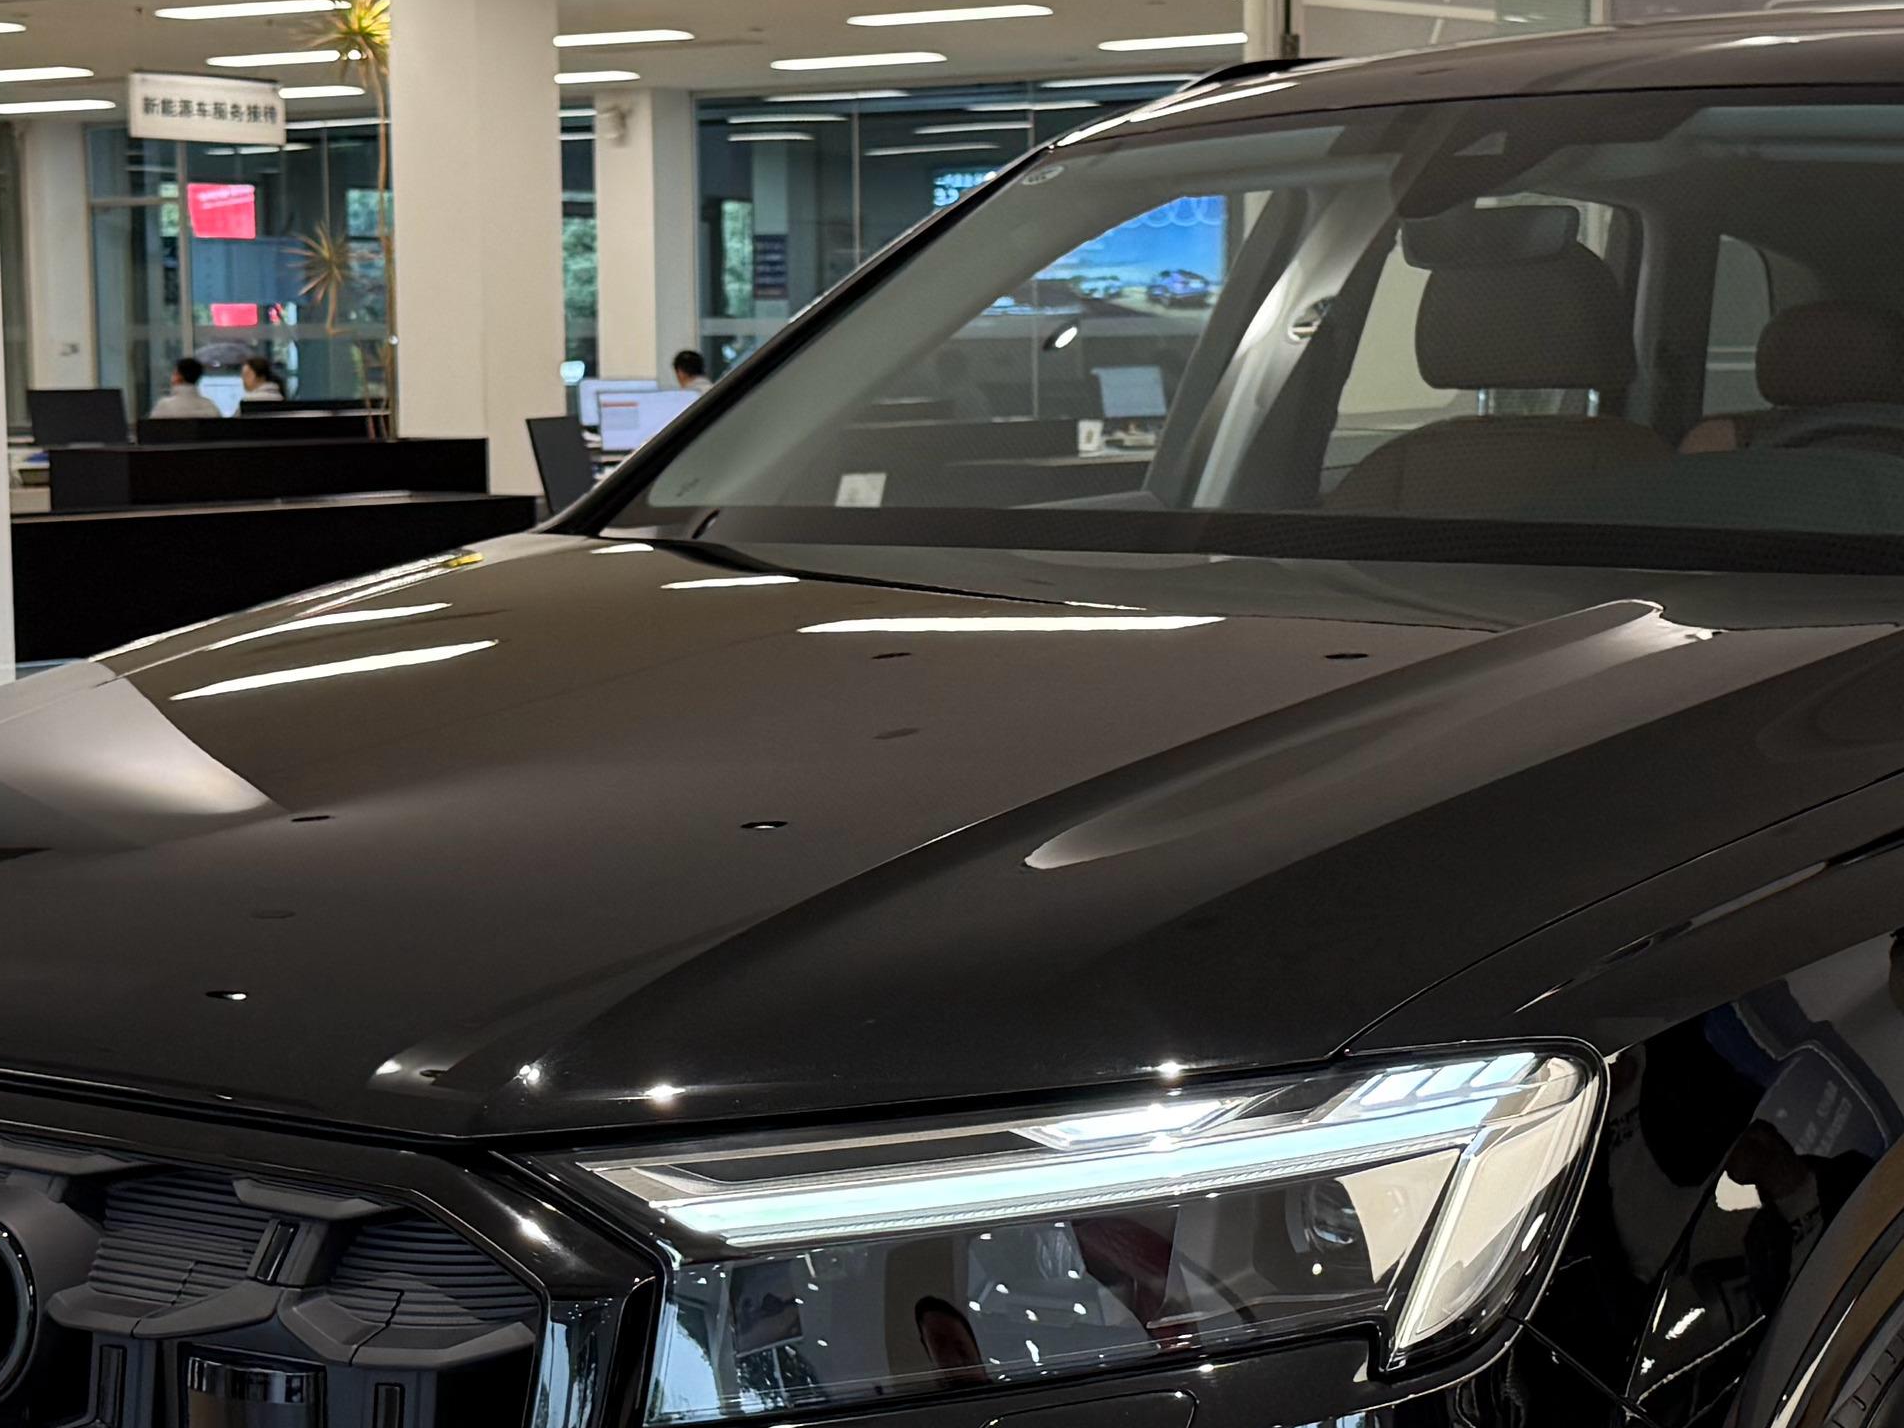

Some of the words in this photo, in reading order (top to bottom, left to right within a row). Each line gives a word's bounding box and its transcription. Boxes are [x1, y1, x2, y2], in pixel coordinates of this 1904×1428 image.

[143, 96, 278, 124] 新能源车服务接待
